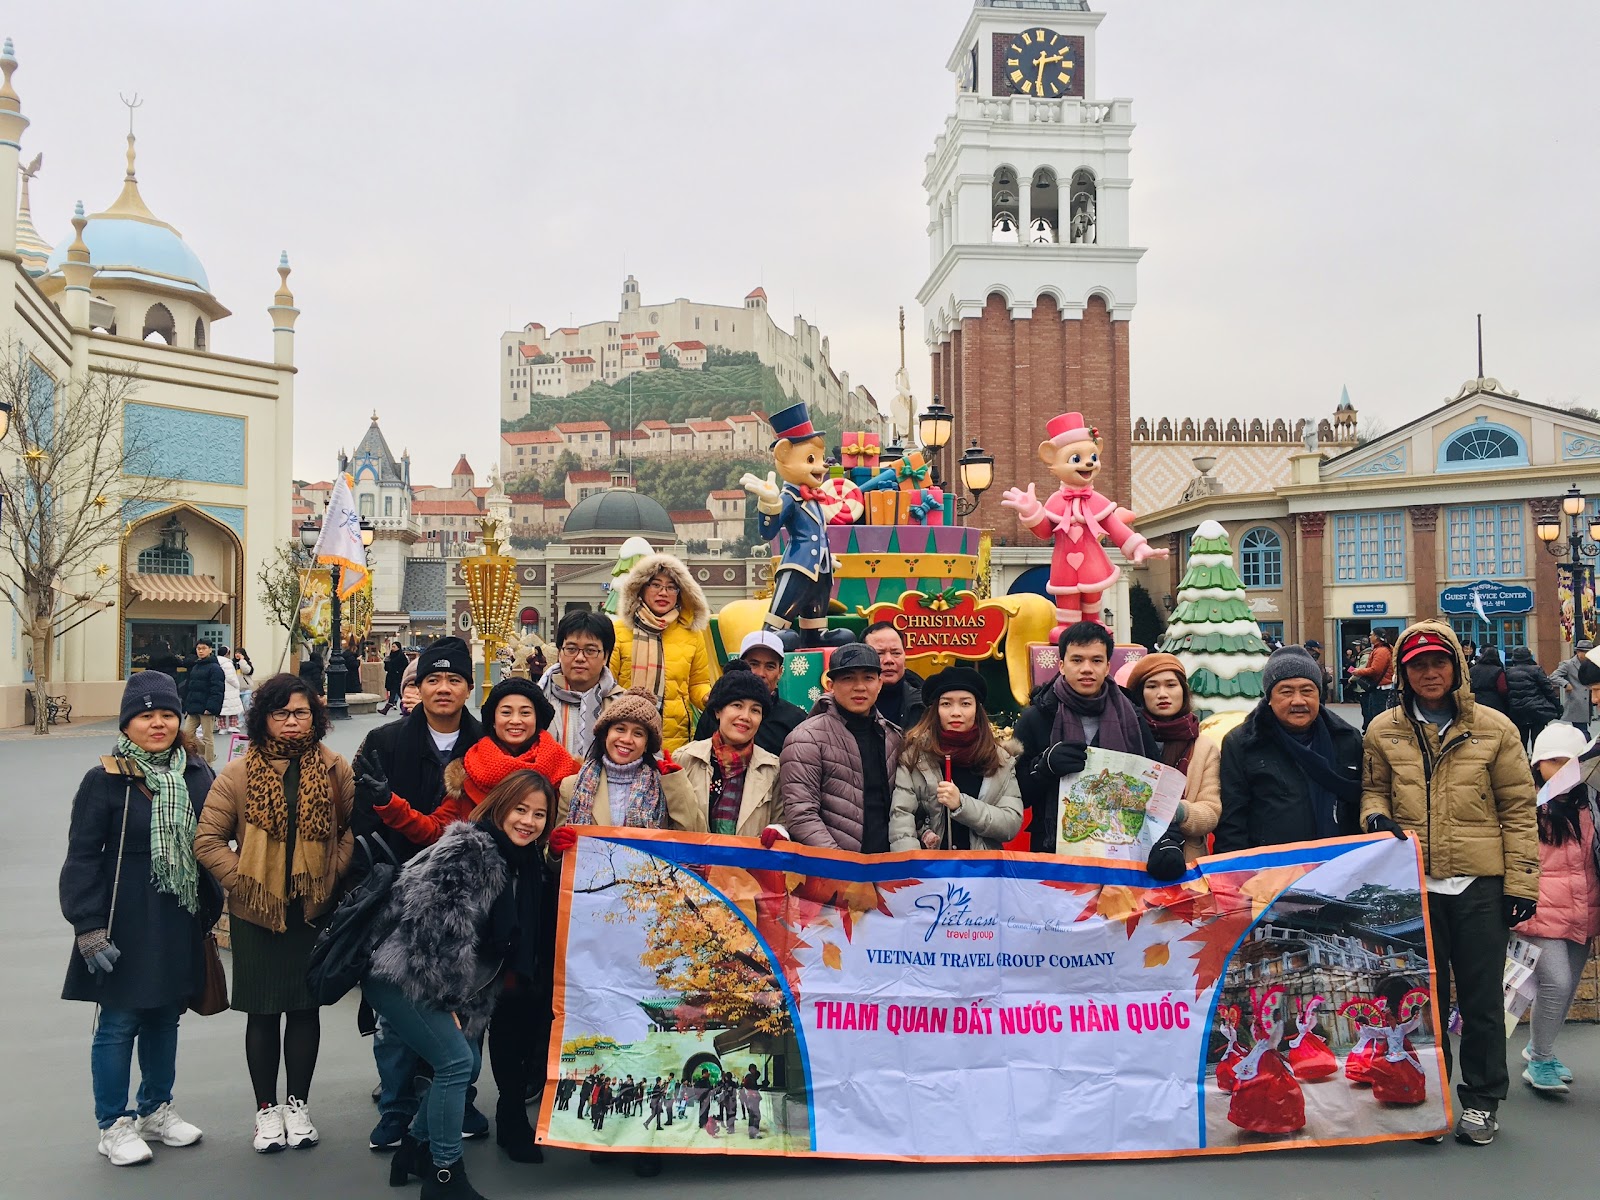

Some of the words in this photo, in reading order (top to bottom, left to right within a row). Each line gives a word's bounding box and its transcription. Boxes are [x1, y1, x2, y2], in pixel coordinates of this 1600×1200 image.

[893, 614, 986, 631] CHRISTMAS
[904, 632, 979, 649] FANTASY
[914, 893, 999, 942] Vietnam
[946, 929, 970, 939] travel
[972, 930, 994, 941] group
[866, 949, 936, 966] VIETNAM
[940, 952, 993, 967] TRAVEL
[1049, 951, 1115, 968] COMANY
[814, 1001, 879, 1031] THAM
[886, 1004, 948, 1035] QUAN
[953, 998, 993, 1035] ĐẤT
[999, 999, 1063, 1034] NƯỚC
[1069, 998, 1120, 1032] HÀN
[1126, 993, 1190, 1031] QUỐC
